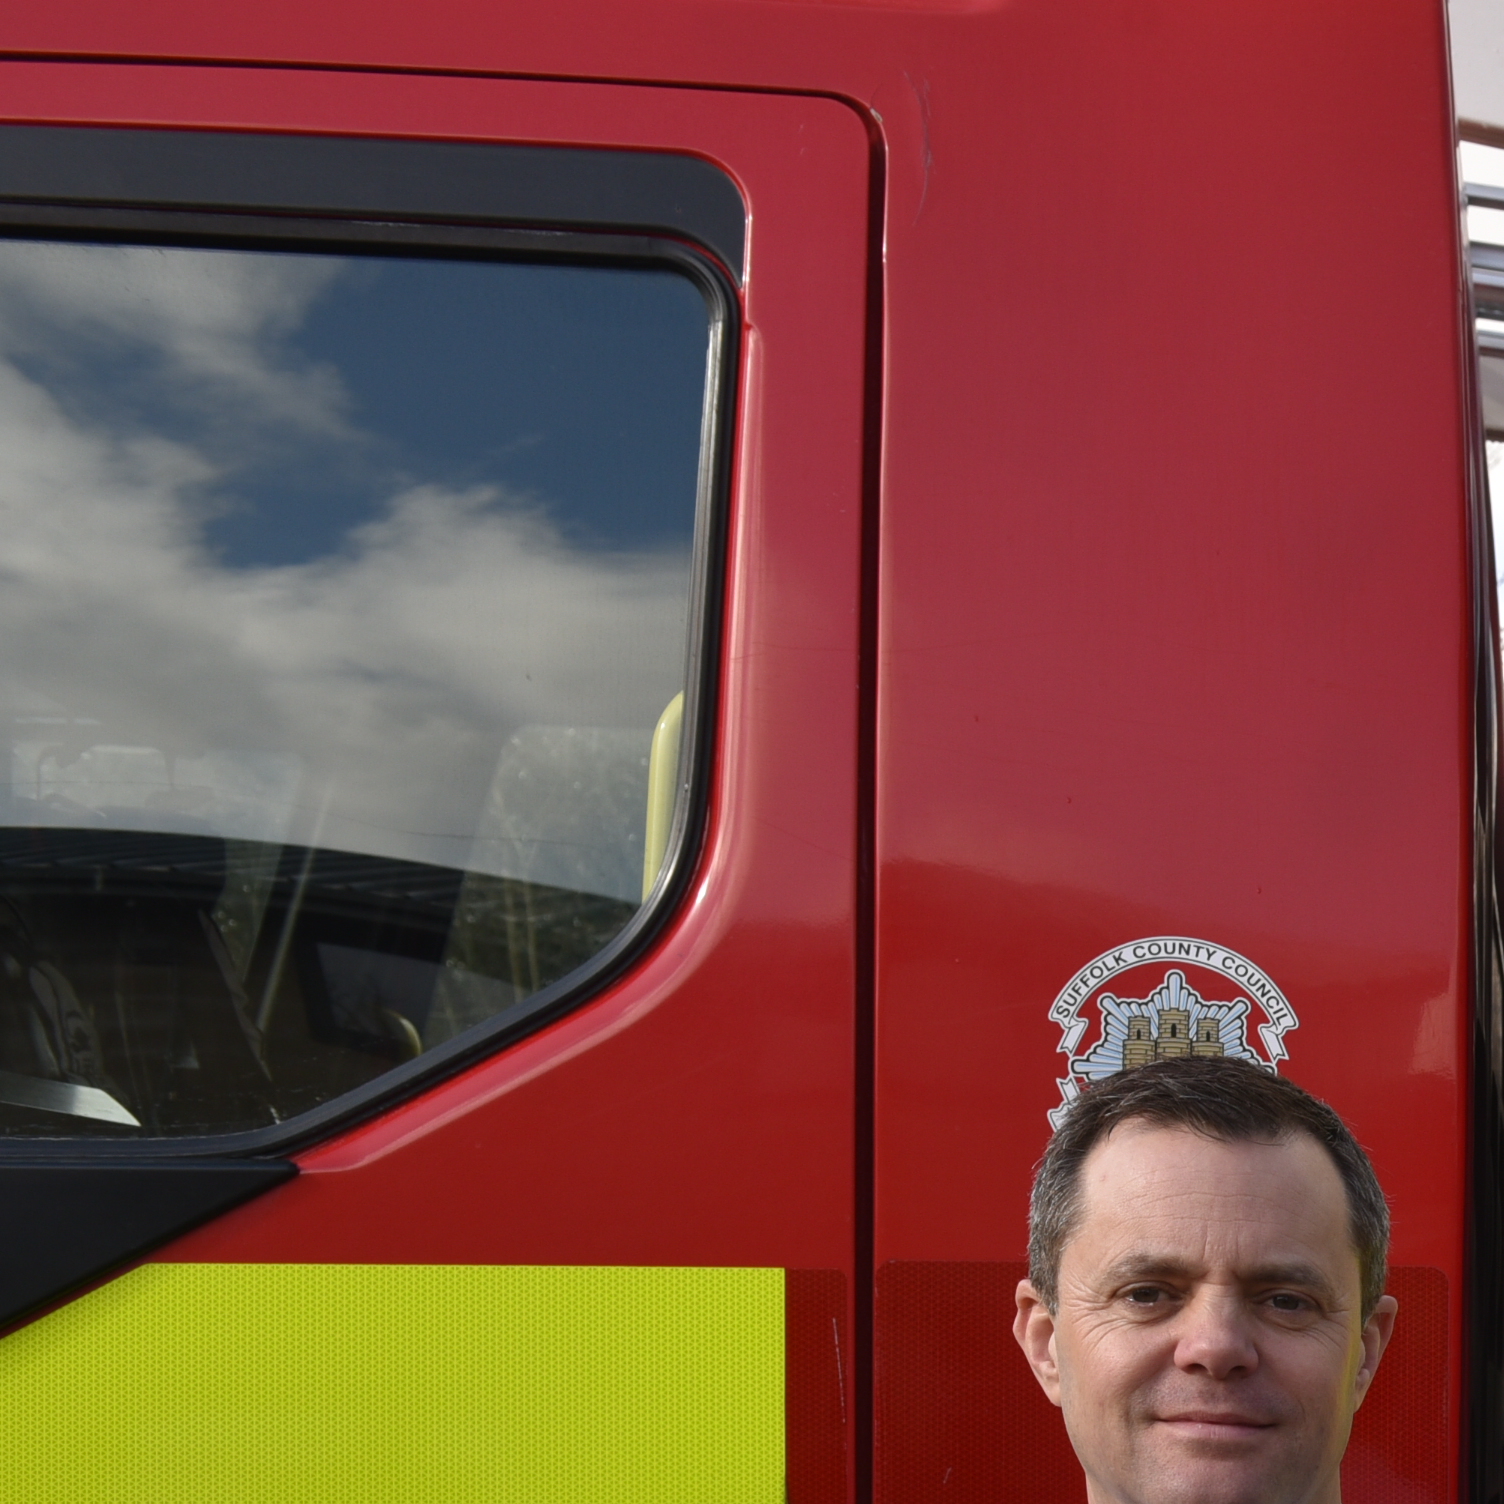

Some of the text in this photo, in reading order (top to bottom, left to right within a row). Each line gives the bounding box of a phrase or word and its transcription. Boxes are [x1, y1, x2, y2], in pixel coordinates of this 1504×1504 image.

[1055, 942, 1290, 1027] SUFFOLK COUNTY COUNCIL
